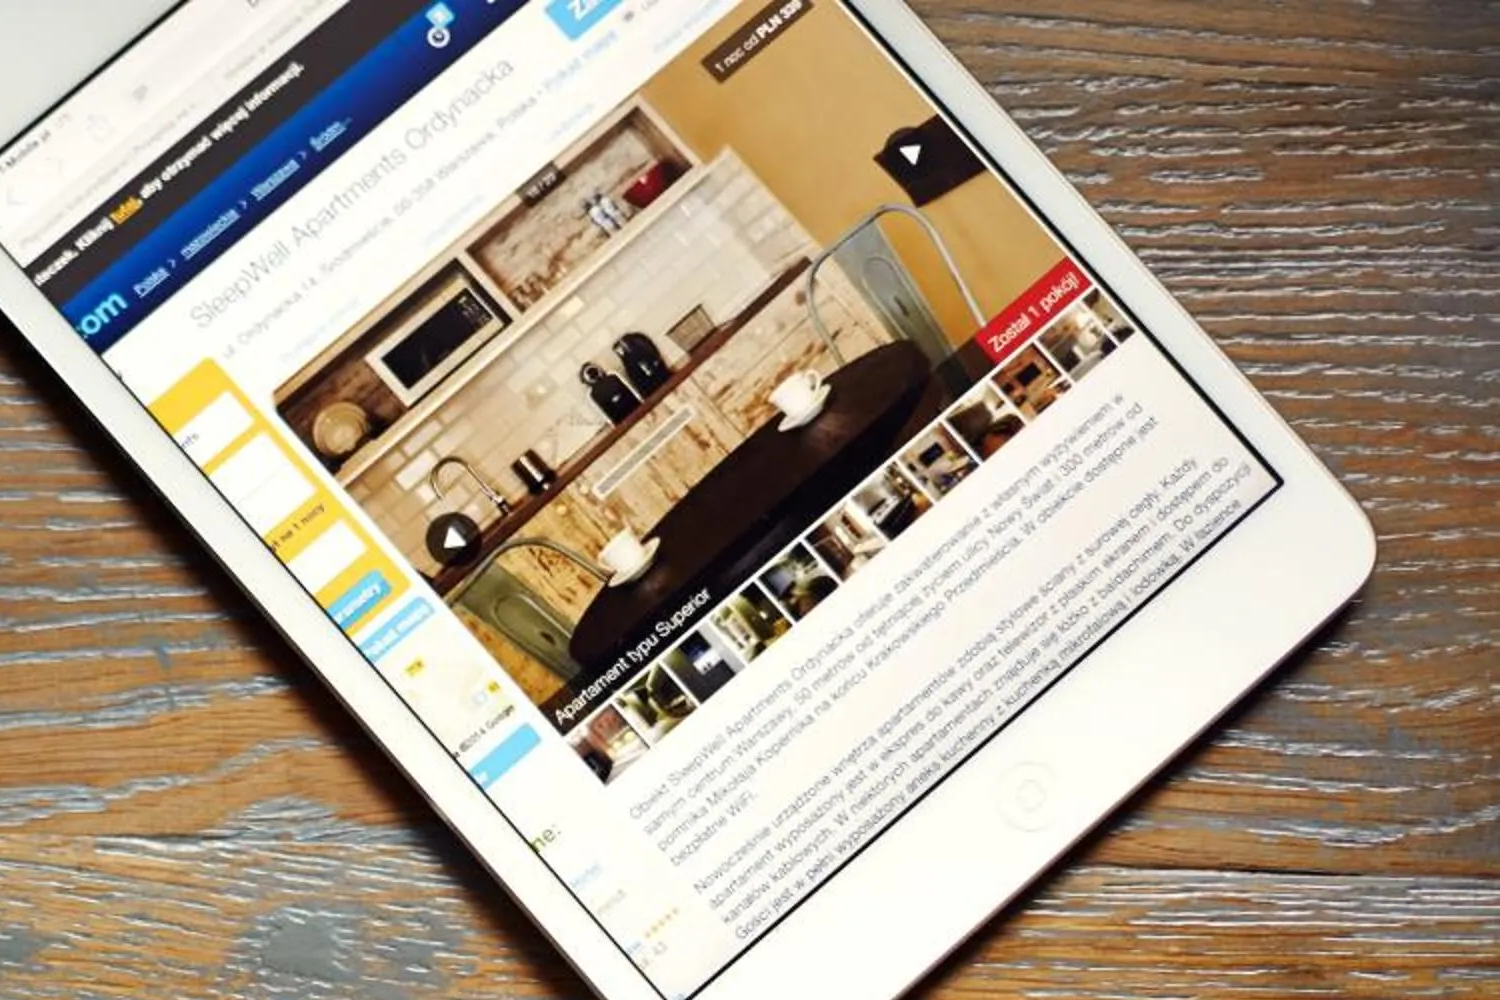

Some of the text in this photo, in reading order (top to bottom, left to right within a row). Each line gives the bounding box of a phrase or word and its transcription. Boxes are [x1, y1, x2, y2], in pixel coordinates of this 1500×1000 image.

[187, 239, 292, 327] SleepWell
[286, 148, 408, 246] Apartments
[402, 60, 517, 152] Ordynacka
[1025, 303, 1041, 320] 1
[550, 587, 714, 726] Apartament typu Superior
